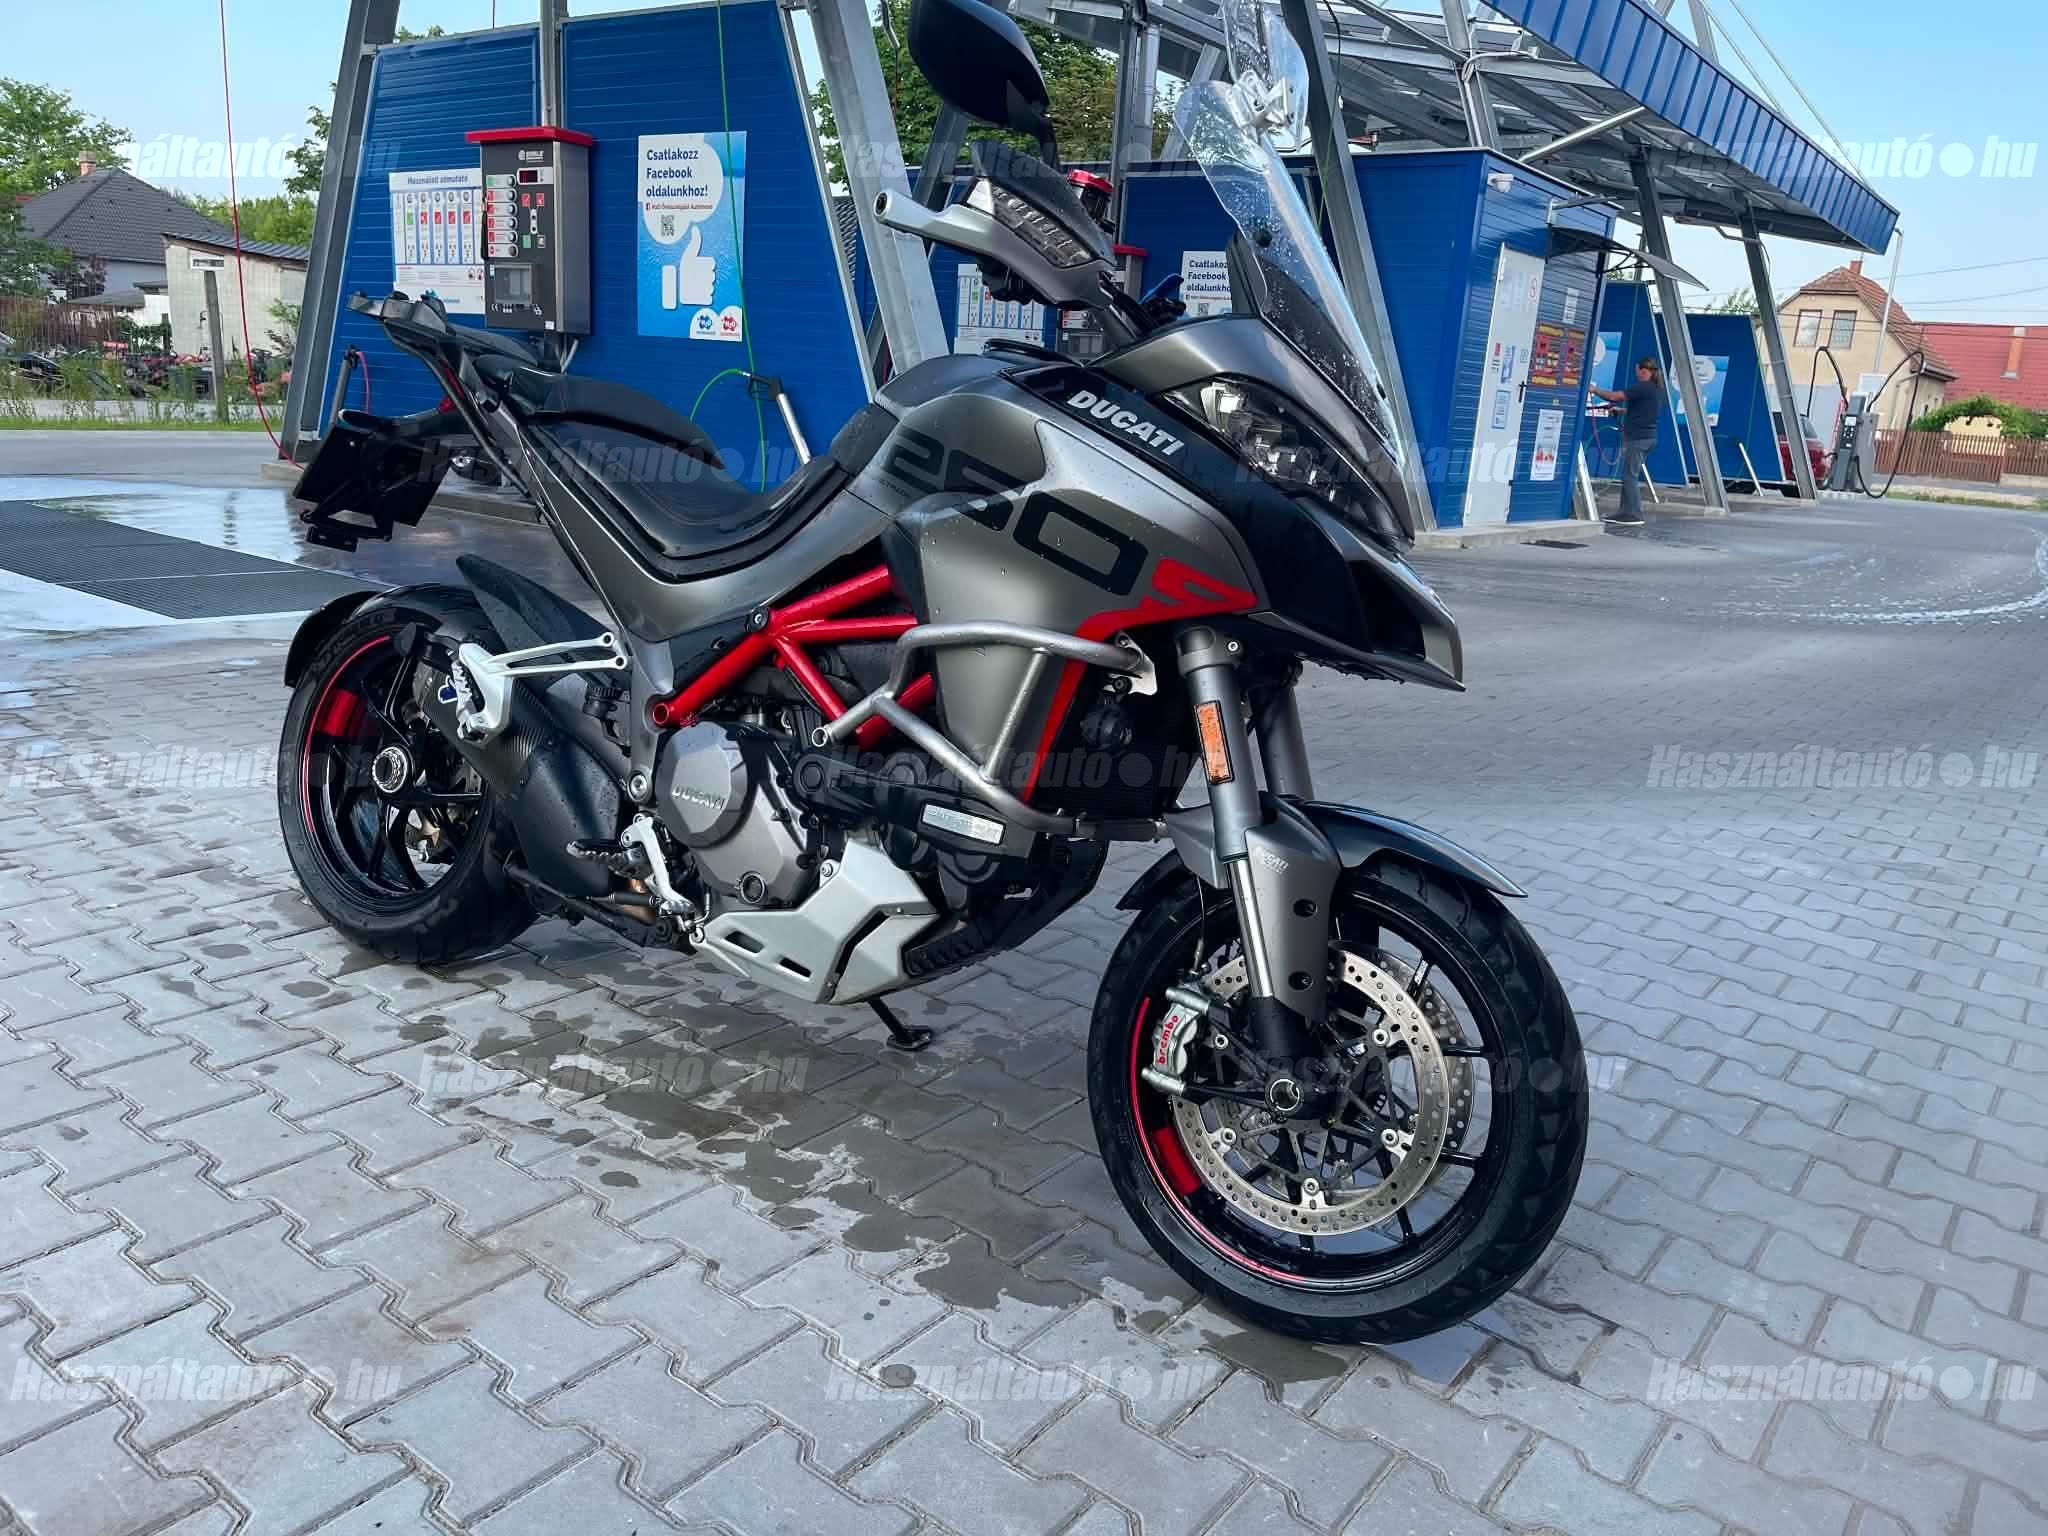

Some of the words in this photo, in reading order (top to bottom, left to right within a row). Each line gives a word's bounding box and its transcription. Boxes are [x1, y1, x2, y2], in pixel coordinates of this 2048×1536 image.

[646, 148, 699, 161] Csatlakozz
[646, 166, 693, 179] Facebook
[646, 185, 708, 197] oldalunkhoz!
[1189, 259, 1228, 269] Csatlakoz
[1188, 271, 1227, 280] Facebook
[1187, 283, 1232, 292] oldalunkho
[1066, 389, 1185, 456] DUCATI
[1156, 1015, 1179, 1065] brembo
